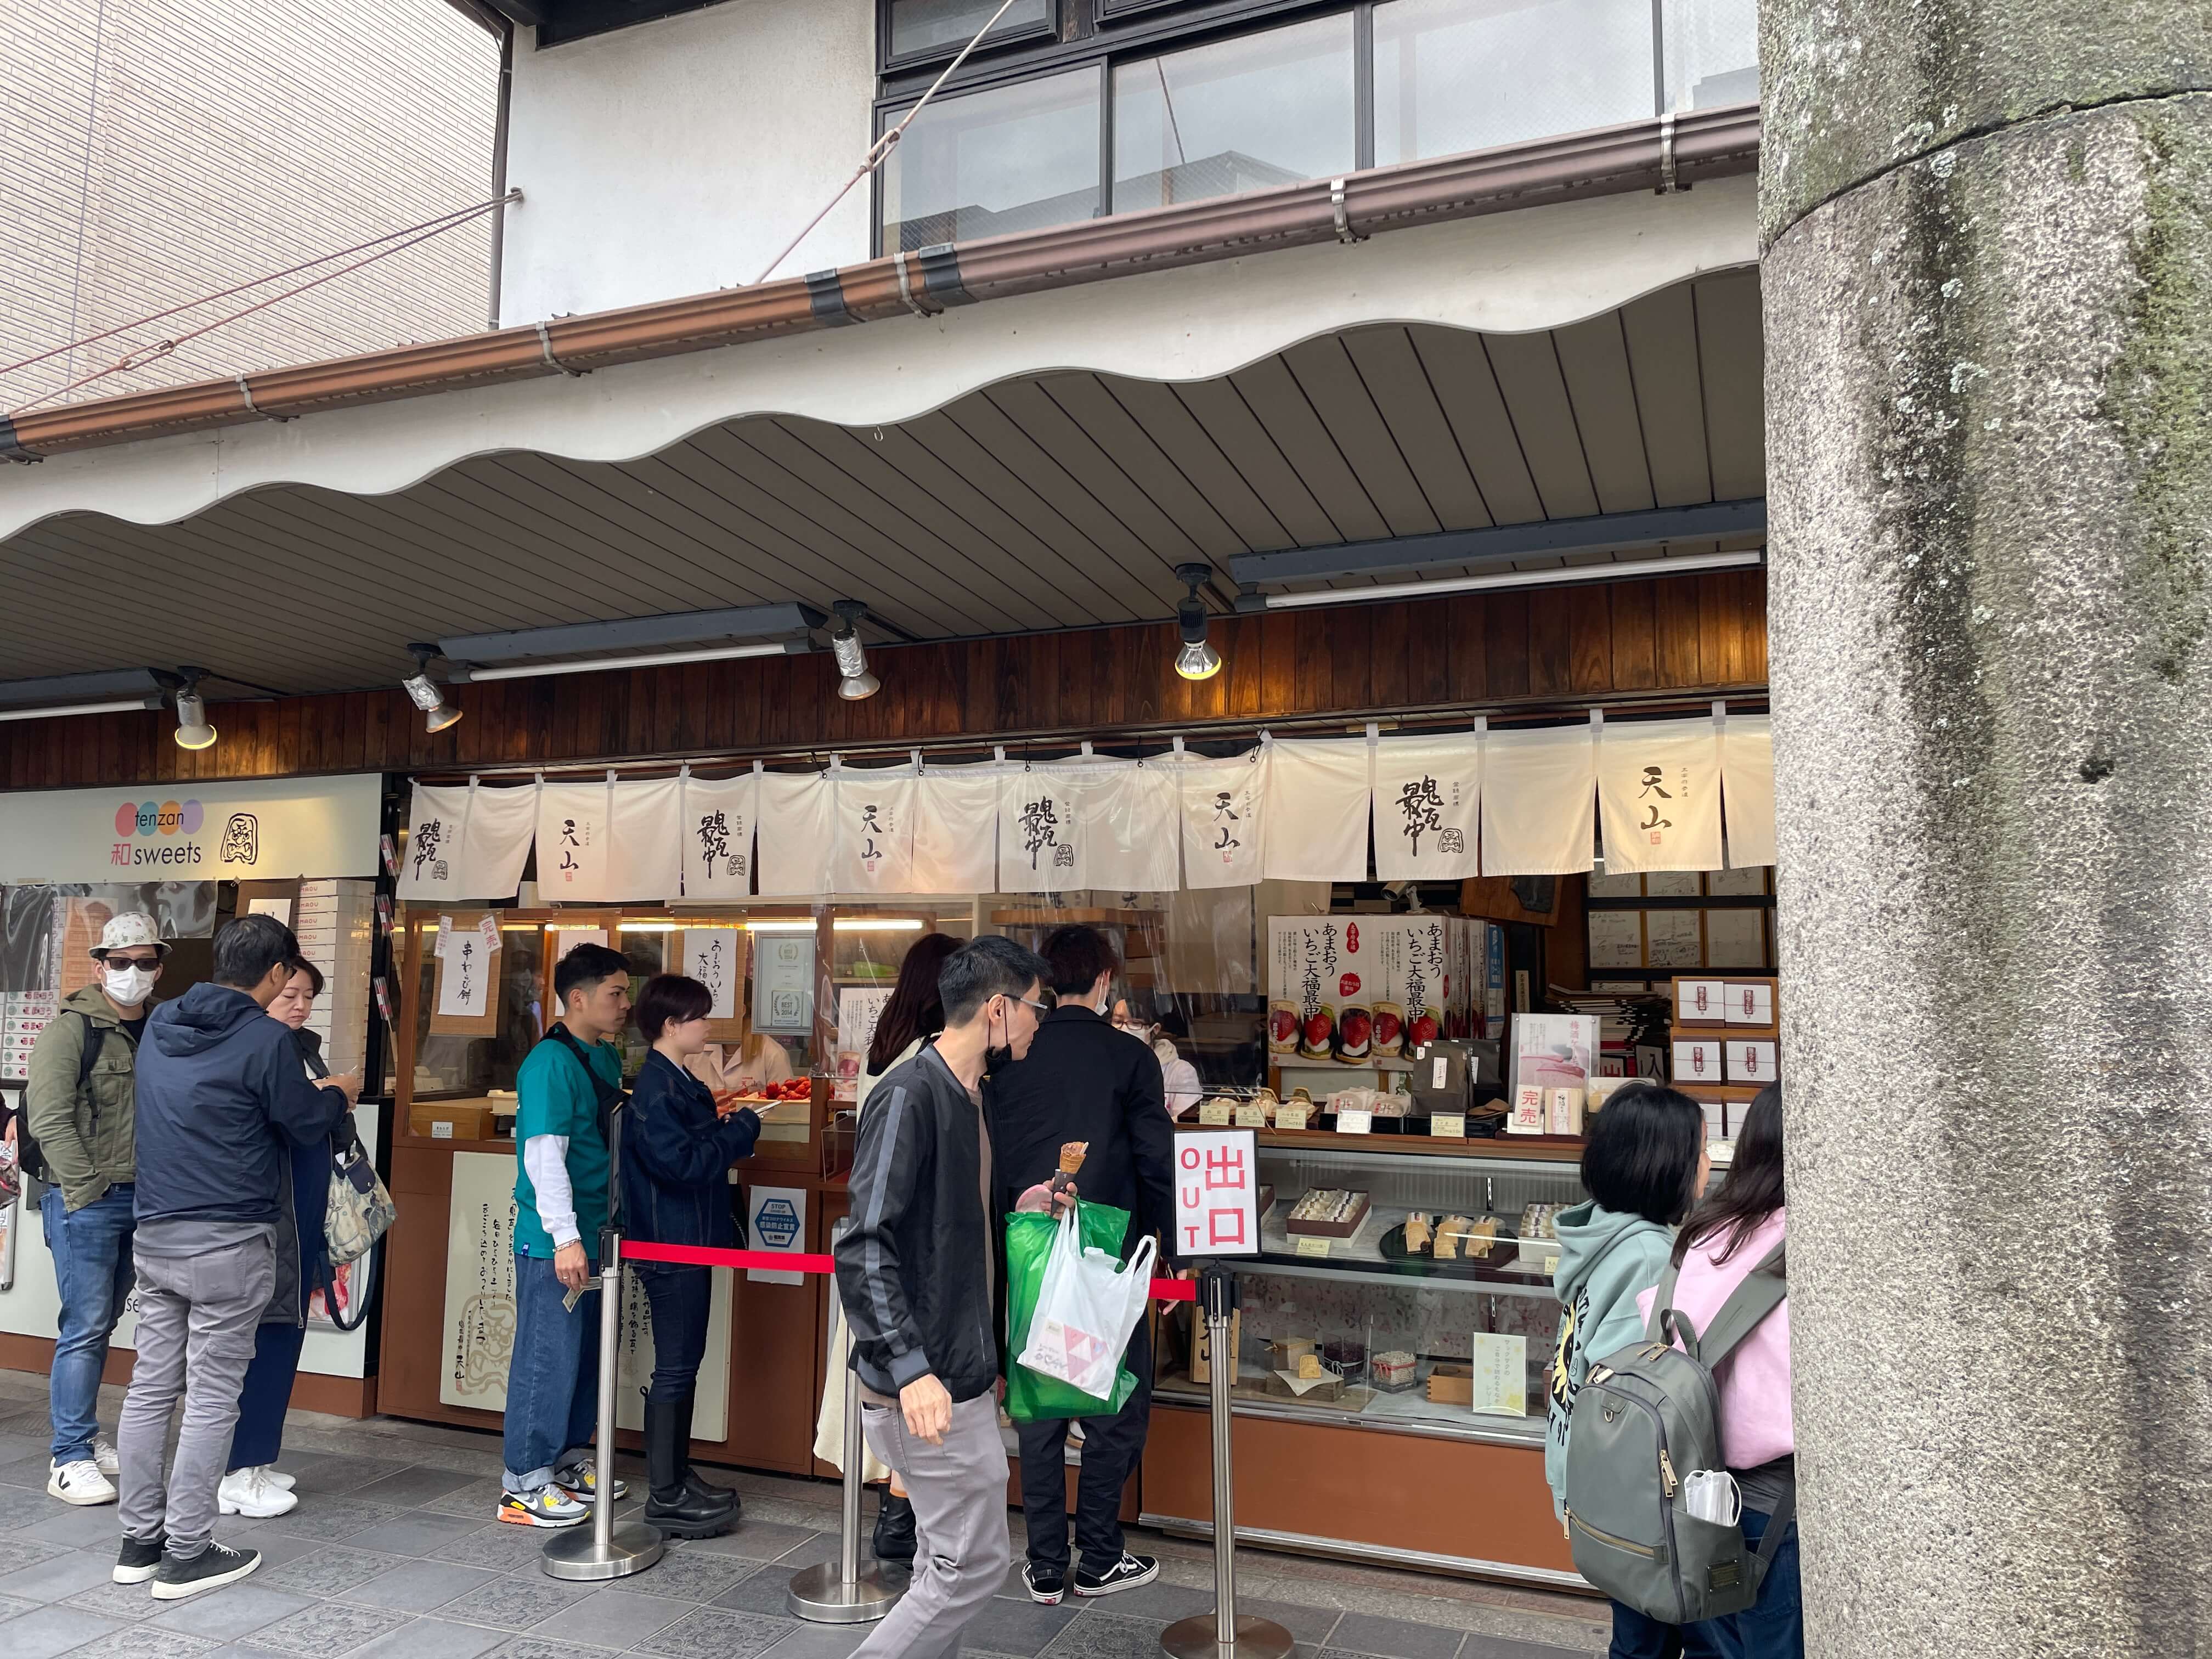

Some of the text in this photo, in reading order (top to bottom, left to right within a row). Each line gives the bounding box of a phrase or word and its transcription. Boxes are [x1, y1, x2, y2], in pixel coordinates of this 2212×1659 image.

[135, 811, 184, 827] tenzan
[1214, 792, 1242, 849] 天山
[1638, 766, 1672, 830] 天山
[111, 842, 201, 865] 和 sweets
[560, 820, 580, 870] 天山
[861, 805, 882, 859] 天山
[481, 920, 498, 949] 完売
[1322, 922, 1338, 978] あまおう
[1427, 923, 1443, 979] あまおう
[1301, 928, 1322, 1021] いちご大福最中
[1405, 928, 1426, 1022] いちご大福最中
[1520, 1090, 1539, 1124] 完売
[1181, 1148, 1200, 1248] OUT
[1205, 1146, 1245, 1246] 出口
